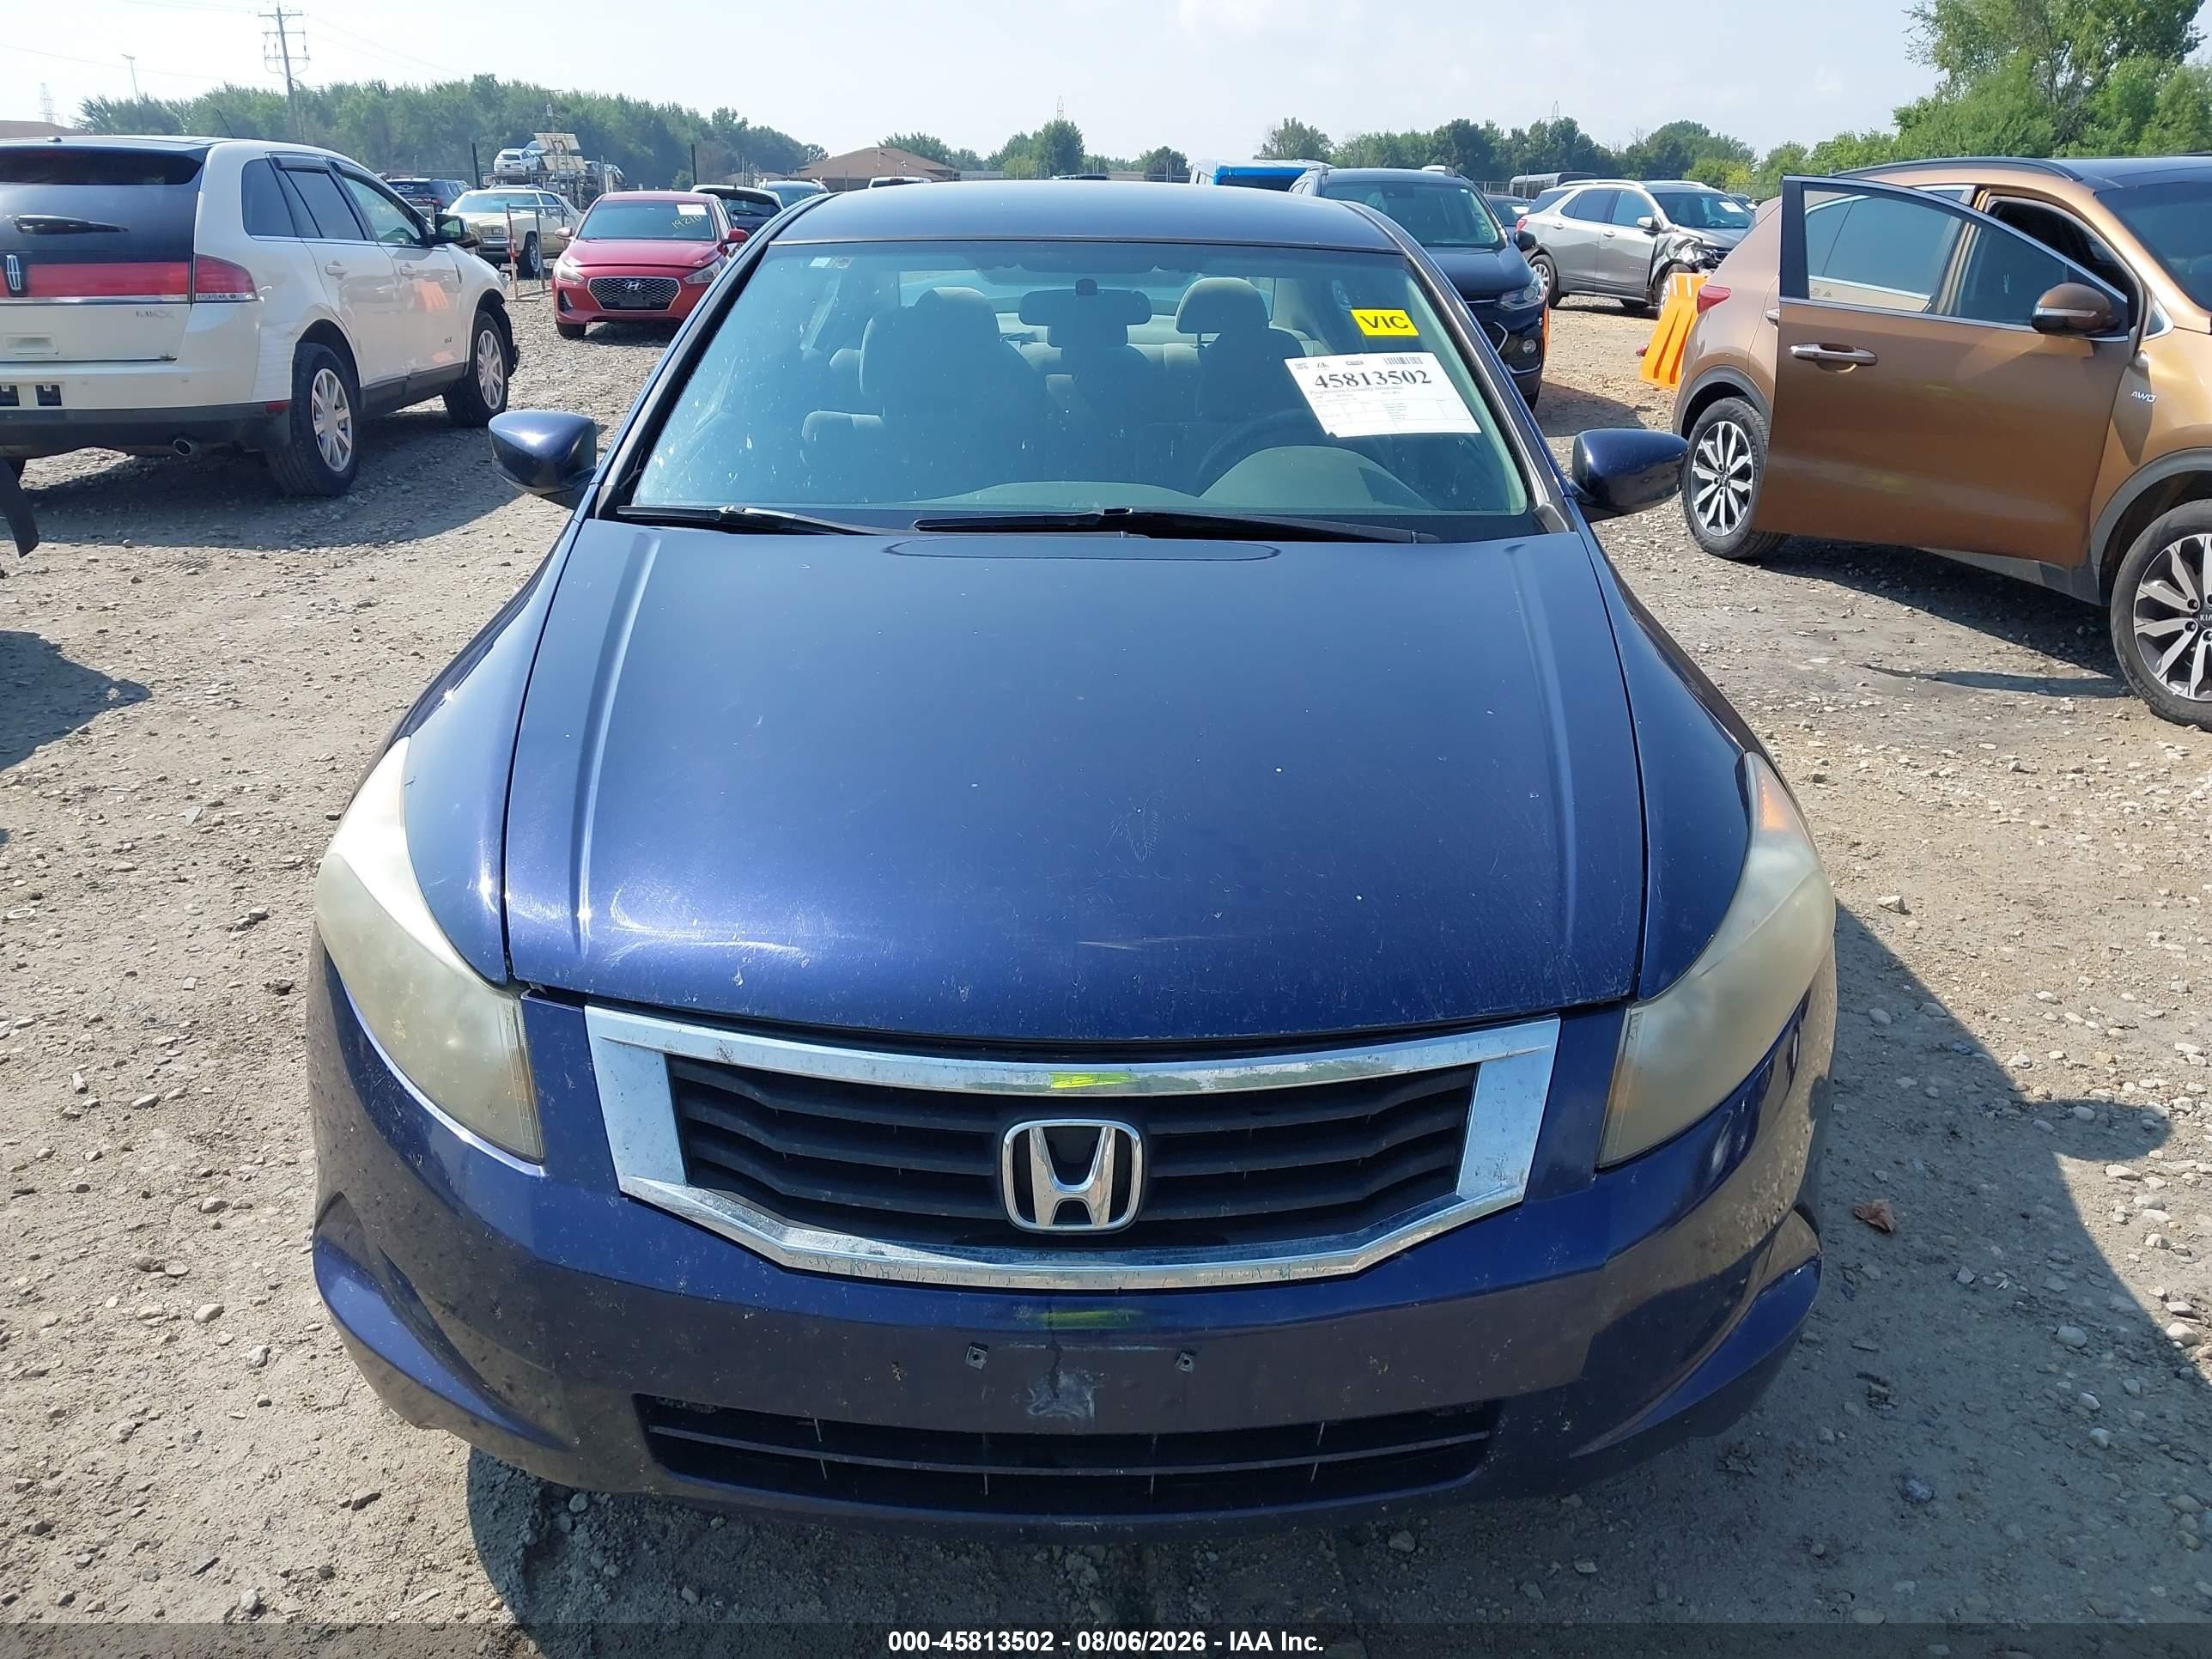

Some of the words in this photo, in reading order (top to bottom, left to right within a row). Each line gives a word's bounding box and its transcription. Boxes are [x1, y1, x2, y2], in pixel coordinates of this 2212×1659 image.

[671, 215, 702, 229] 19210
[1358, 315, 1409, 329] VIC
[1315, 370, 1431, 388] 45813502
[2130, 391, 2157, 403] AWD
